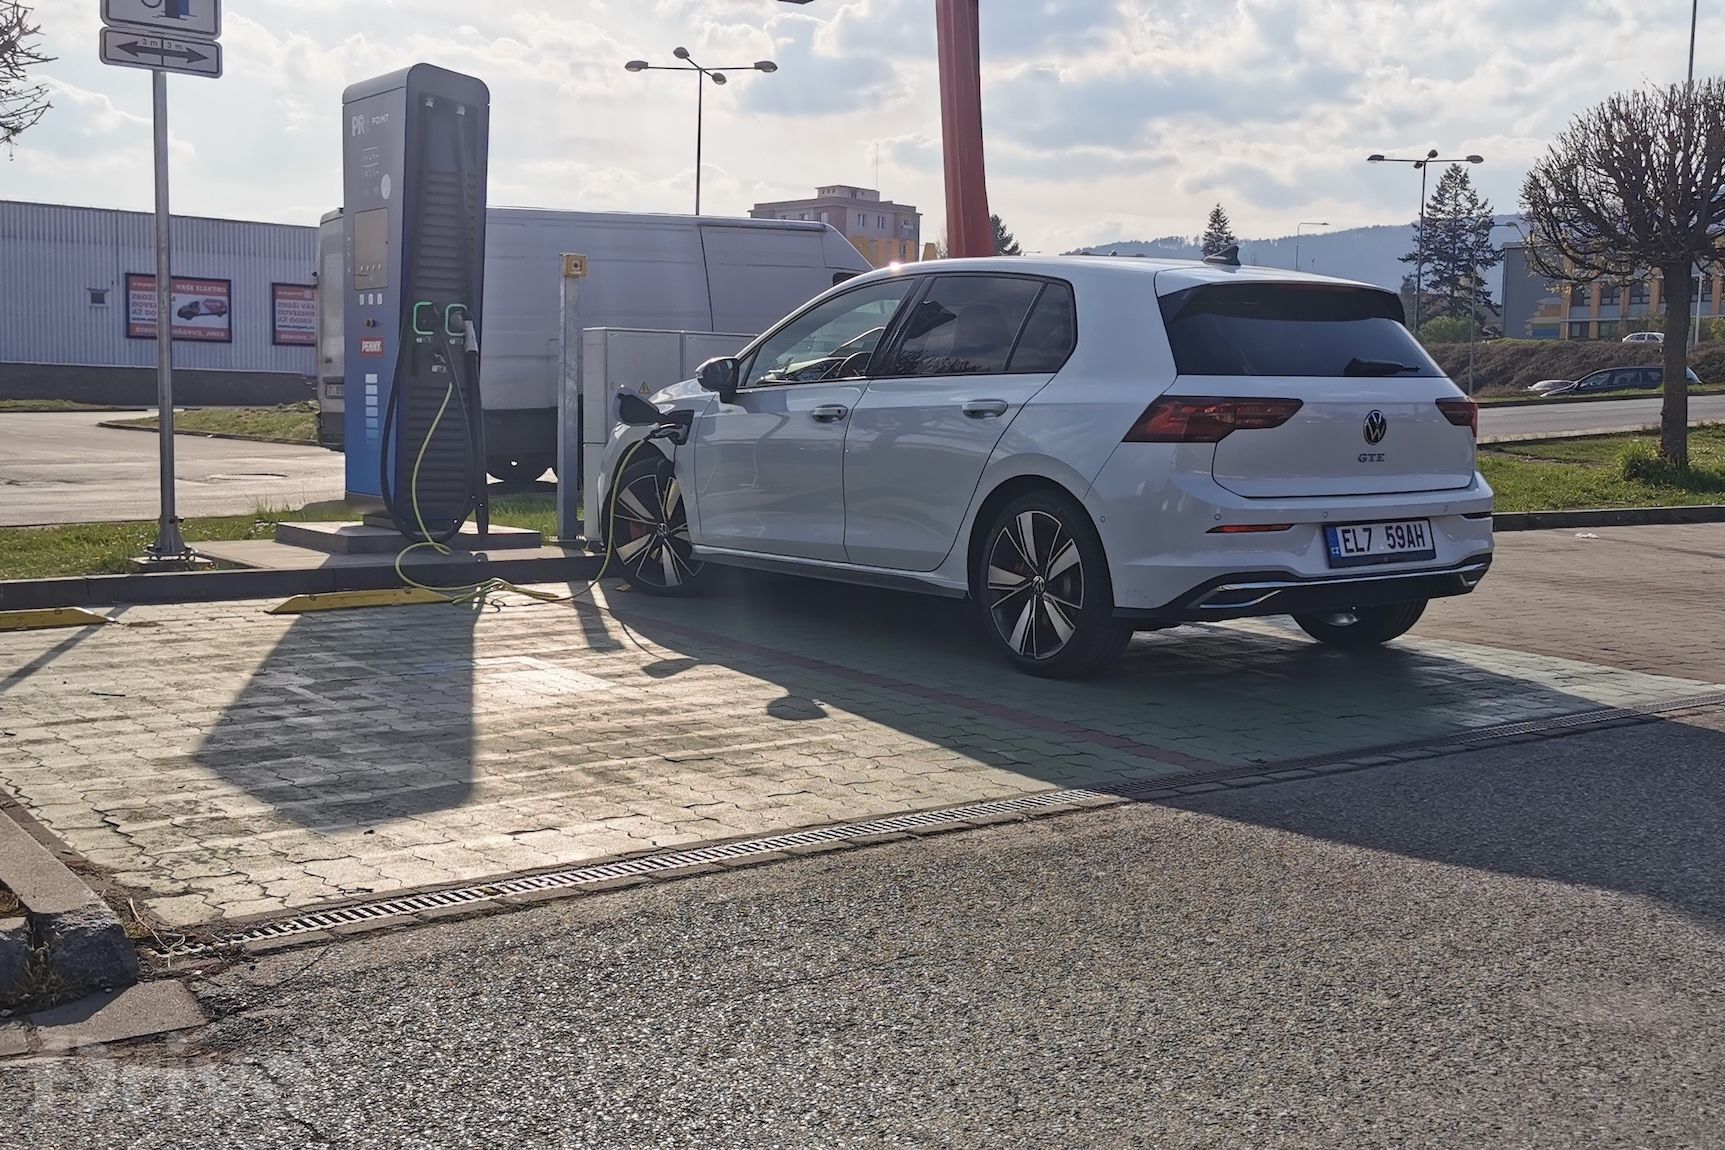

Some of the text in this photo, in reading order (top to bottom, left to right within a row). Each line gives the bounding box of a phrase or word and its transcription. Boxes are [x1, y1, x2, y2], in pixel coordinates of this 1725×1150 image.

[142, 38, 148, 46] 3
[167, 41, 173, 49] 3
[372, 113, 390, 125] POINT
[1357, 453, 1385, 463] GTE
[1341, 523, 1426, 553] EL7 59AH
